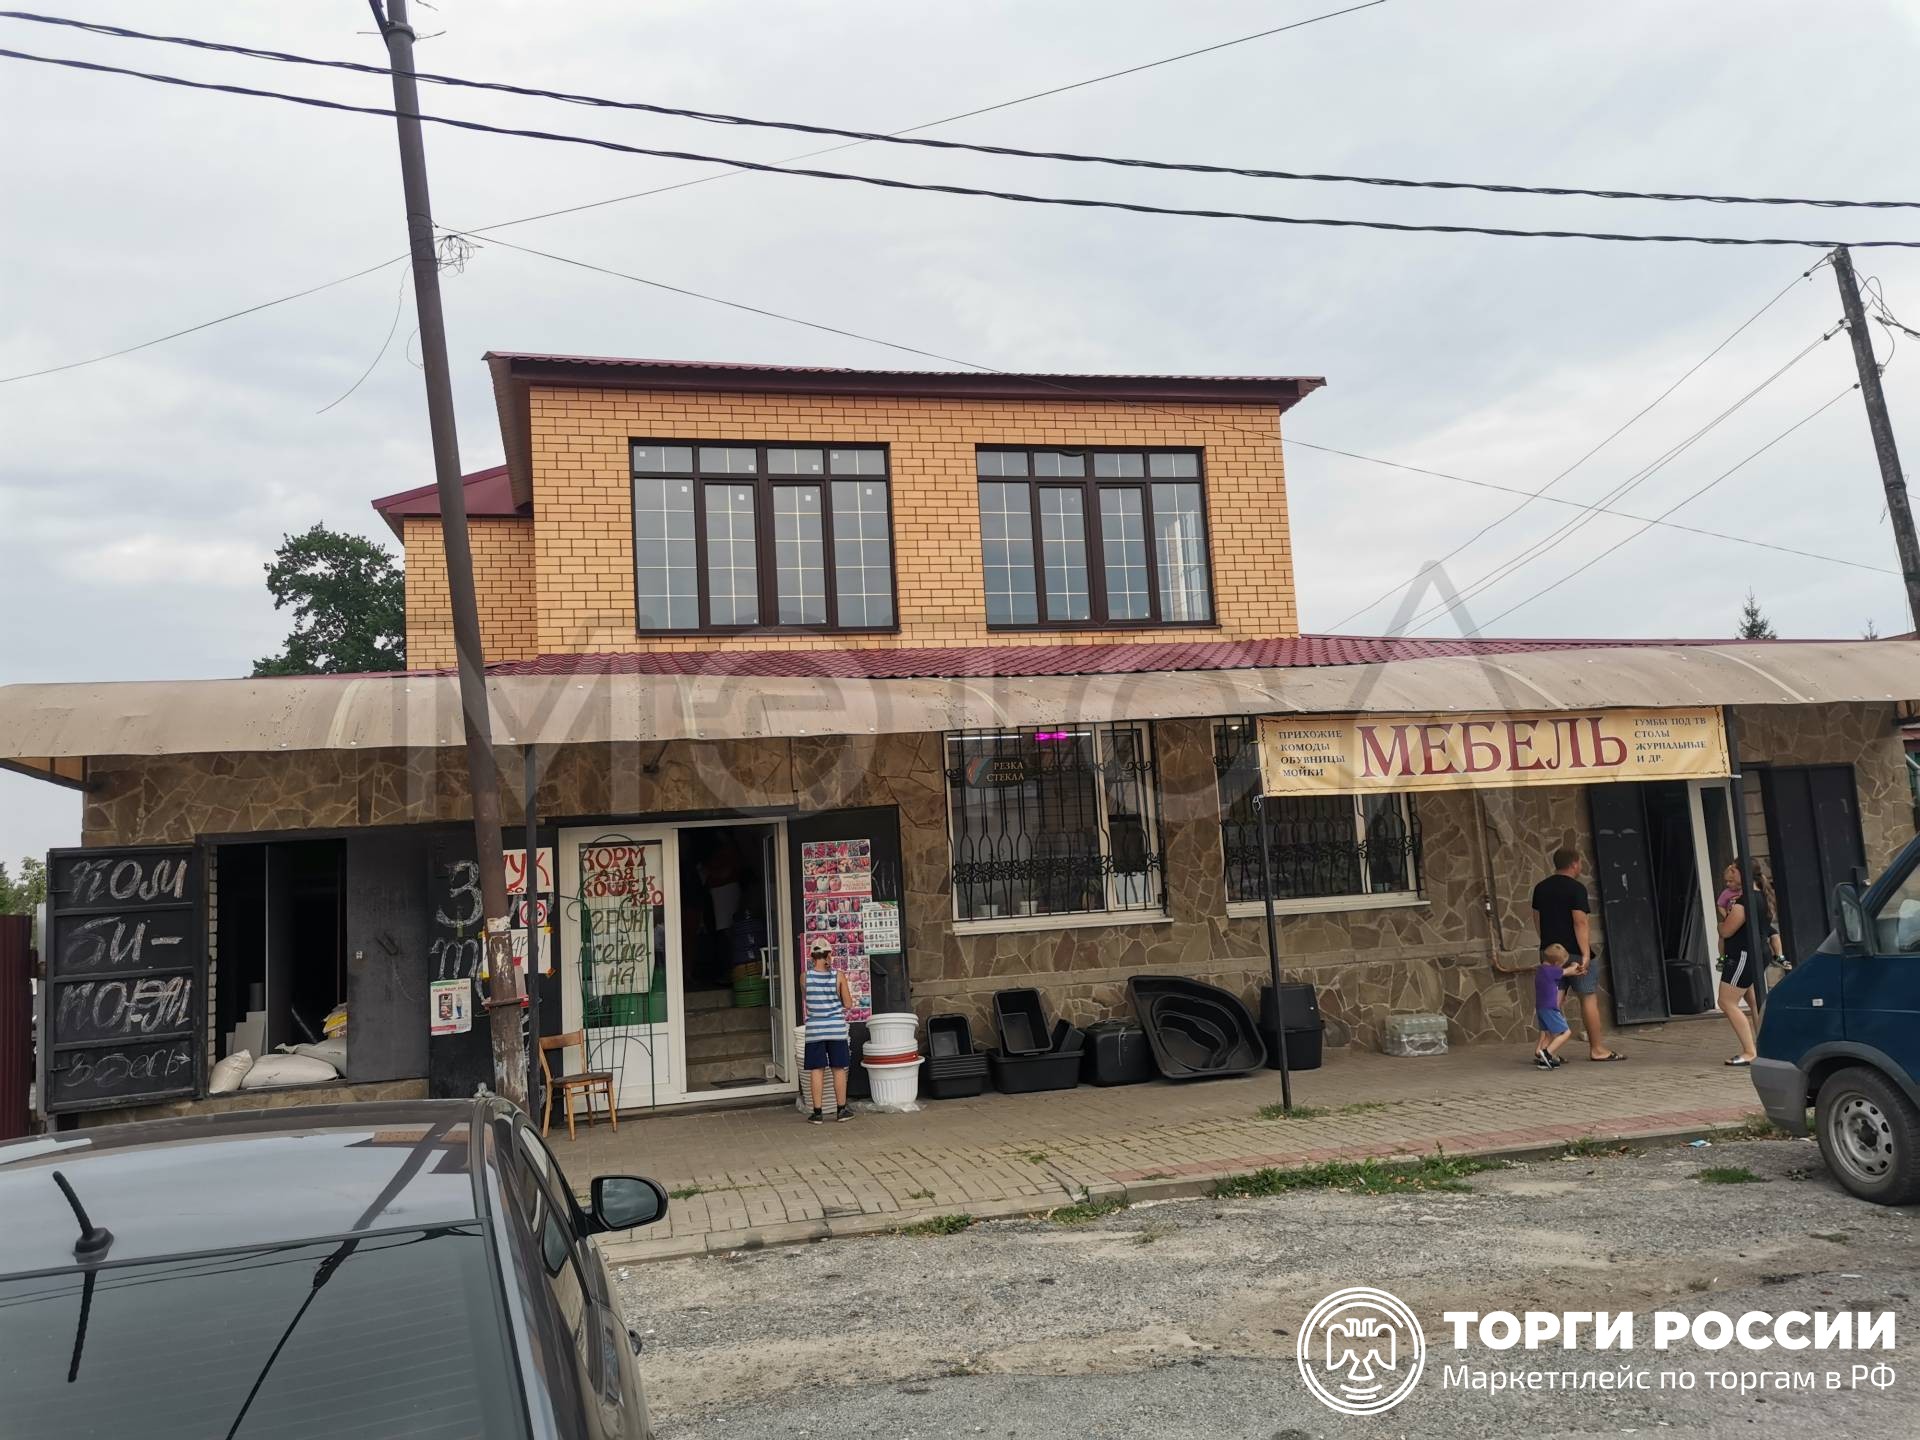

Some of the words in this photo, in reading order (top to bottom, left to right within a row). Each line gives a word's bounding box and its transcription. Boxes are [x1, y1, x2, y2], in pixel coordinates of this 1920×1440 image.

[1634, 718, 1667, 727] ТУМБЫ
[1671, 717, 1691, 726] ПОД
[1694, 717, 1706, 725] ТВ
[1278, 730, 1343, 739] ПРИХОЖИЕ
[1634, 730, 1670, 738] СТОЛЫ
[1280, 743, 1330, 752] КОМОДЫ
[1354, 716, 1628, 778] МЕБЕЛЬ
[1636, 741, 1706, 751] ЖУРНАЛЬНЫЕ
[1280, 755, 1345, 765] ОБУВНИЦЫ
[1637, 755, 1644, 763] И
[993, 761, 1024, 771] РЕЗКА
[1283, 766, 1324, 777] МОЙКИ
[986, 772, 1025, 782] СТЕКЛА
[584, 846, 647, 871] КОРМ
